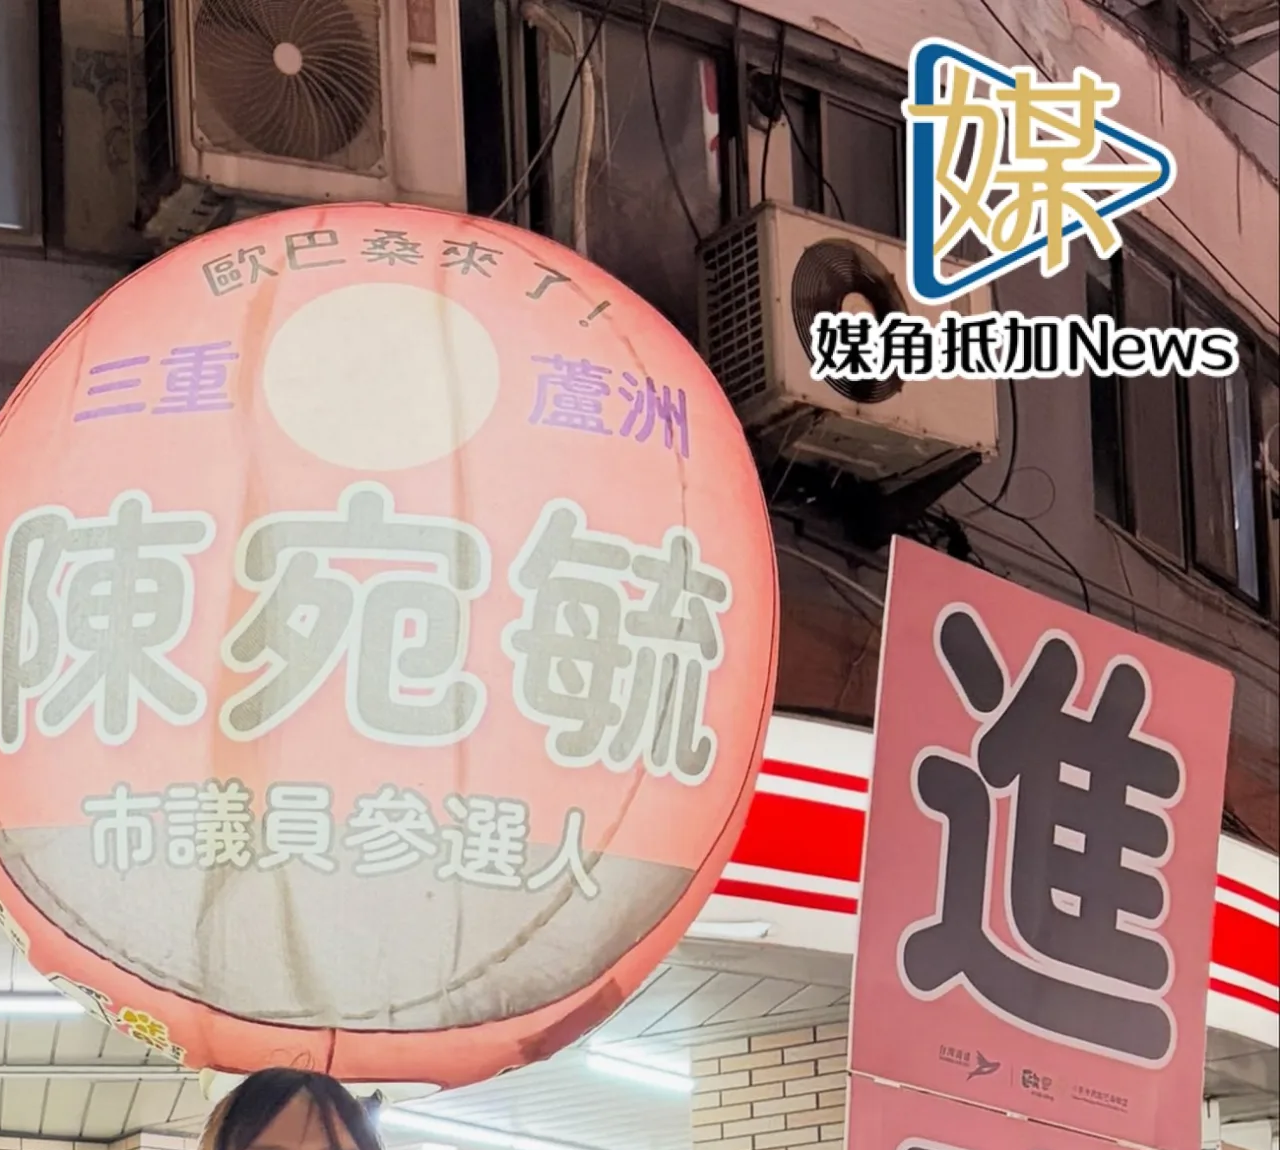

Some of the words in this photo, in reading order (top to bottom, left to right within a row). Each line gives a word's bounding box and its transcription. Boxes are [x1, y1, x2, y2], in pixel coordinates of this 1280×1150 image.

[72, 341, 240, 424] 三重
[526, 351, 691, 460] 蘆洲
[82, 779, 600, 900] 市議員參選人
